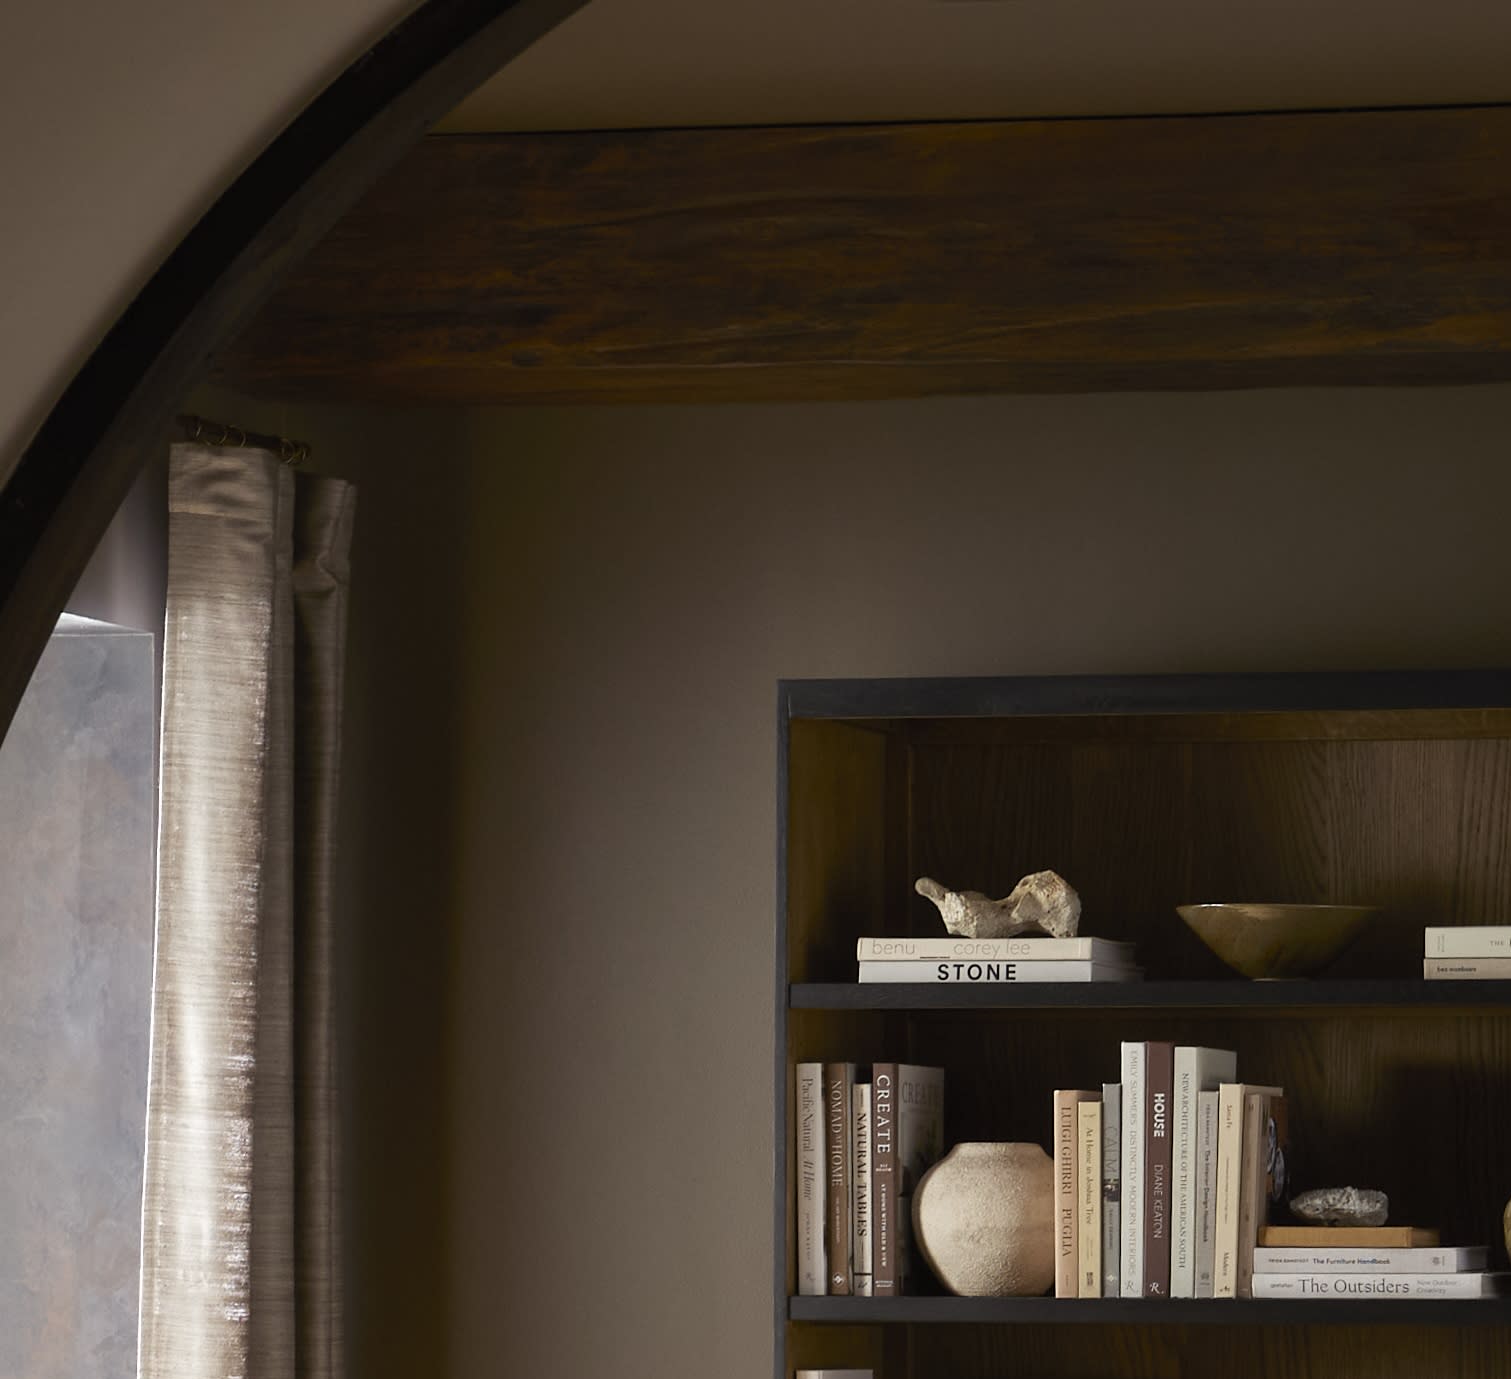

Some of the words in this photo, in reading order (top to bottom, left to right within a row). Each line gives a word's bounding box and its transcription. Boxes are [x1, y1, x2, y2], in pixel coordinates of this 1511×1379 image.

[872, 939, 915, 956] benu
[953, 943, 1001, 961] corey
[1005, 938, 1032, 956] lee
[937, 963, 1018, 981] STONE
[1129, 1049, 1139, 1078] EMILY
[801, 1078, 815, 1113] Pacific
[830, 1079, 843, 1133] NOMAD
[1129, 1080, 1139, 1126] SUMMERS
[876, 1074, 891, 1155] CREATE
[1061, 1107, 1072, 1143] LUIGI
[1086, 1127, 1096, 1137] At
[1154, 1092, 1166, 1138] HOUSE
[1181, 1094, 1189, 1159] ARCHITECTURE
[801, 1114, 815, 1152] Natural
[856, 1112, 868, 1177] NATURAL
[1102, 1125, 1118, 1175] CALM
[831, 1145, 843, 1186] HOME
[1086, 1139, 1096, 1164] Home
[1129, 1130, 1139, 1183] DISTINCTLY
[1180, 1161, 1188, 1173] OF
[801, 1168, 815, 1200] Home
[1061, 1147, 1072, 1195] GHIRRI
[1153, 1164, 1164, 1197] DIANE
[1180, 1175, 1188, 1191] THE
[1086, 1176, 1096, 1206] Joshua
[1129, 1185, 1139, 1226] MODERN
[1202, 1187, 1211, 1209] Design
[856, 1184, 868, 1237] TABLES
[1086, 1208, 1096, 1226] Tree
[1153, 1199, 1164, 1239] KEATON
[1179, 1192, 1188, 1237] AMERICAN
[1202, 1210, 1210, 1243] Handbook
[1061, 1208, 1072, 1257] PUGLIA
[1129, 1228, 1139, 1277] INTERIORS
[1178, 1238, 1187, 1269] SOUTH
[1313, 1256, 1325, 1265] The
[1326, 1256, 1356, 1265] Furniture
[1357, 1256, 1391, 1265] Handbook
[1298, 1278, 1329, 1294] The
[1334, 1278, 1410, 1294] Outsiders
